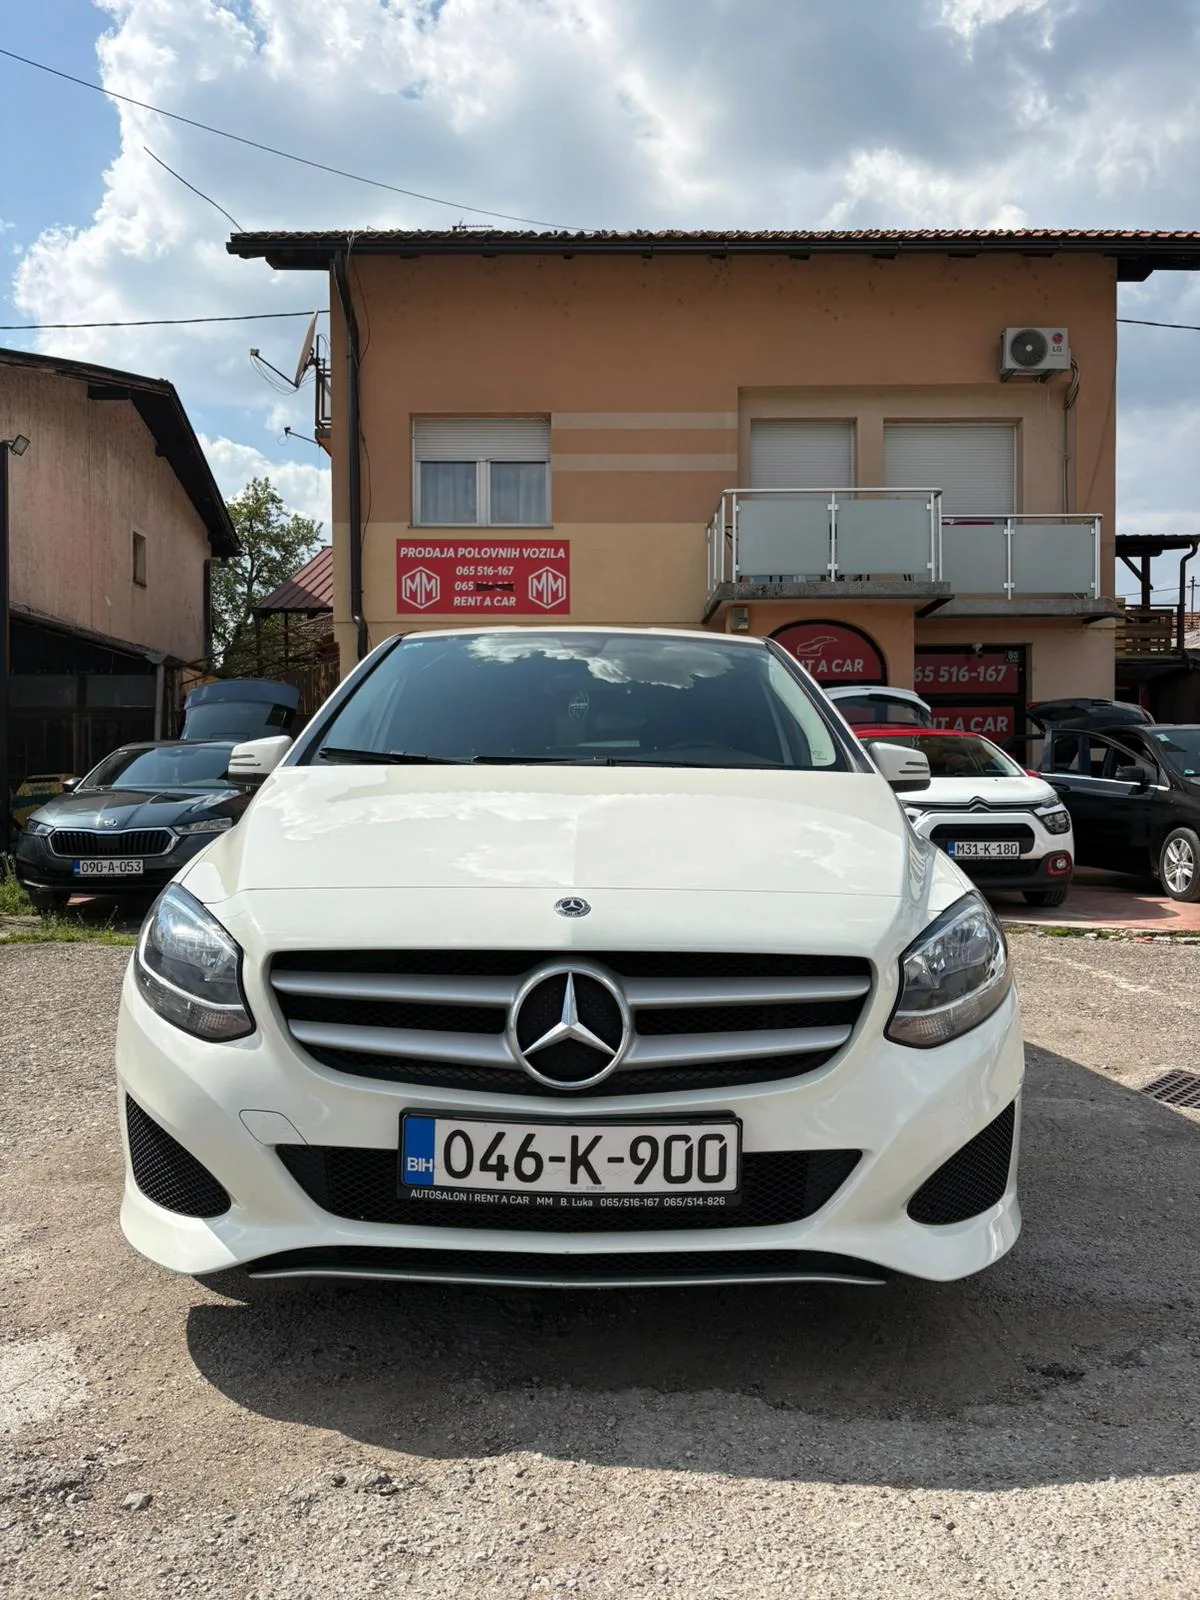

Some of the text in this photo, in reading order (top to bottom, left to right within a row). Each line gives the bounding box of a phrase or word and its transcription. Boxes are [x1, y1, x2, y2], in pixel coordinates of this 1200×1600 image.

[1052, 345, 1063, 353] LG
[400, 547, 565, 559] PRODAJA POLOVNIH VOZILA
[456, 566, 514, 576] 065 516-167
[454, 581, 473, 591] 065
[453, 596, 517, 607] RENT A CAR
[817, 659, 828, 673] A
[831, 659, 864, 673] CAR
[914, 665, 1007, 682] 65 516-167
[953, 716, 965, 732] A
[970, 716, 1009, 732] CAR
[956, 843, 1018, 855] M31-K-180
[81, 861, 142, 873] 090-A-053
[443, 1129, 727, 1185] 046-K-900
[407, 1157, 433, 1173] BIH
[410, 1189, 467, 1201] AUTOSALON
[474, 1191, 499, 1203] RENT
[500, 1194, 509, 1204] A
[509, 1195, 529, 1205] CAR
[536, 1197, 553, 1206] MM
[560, 1198, 569, 1206] B.
[572, 1198, 593, 1207] Luka
[600, 1197, 659, 1207] 065/516-167
[663, 1196, 726, 1207] 065/514-826
